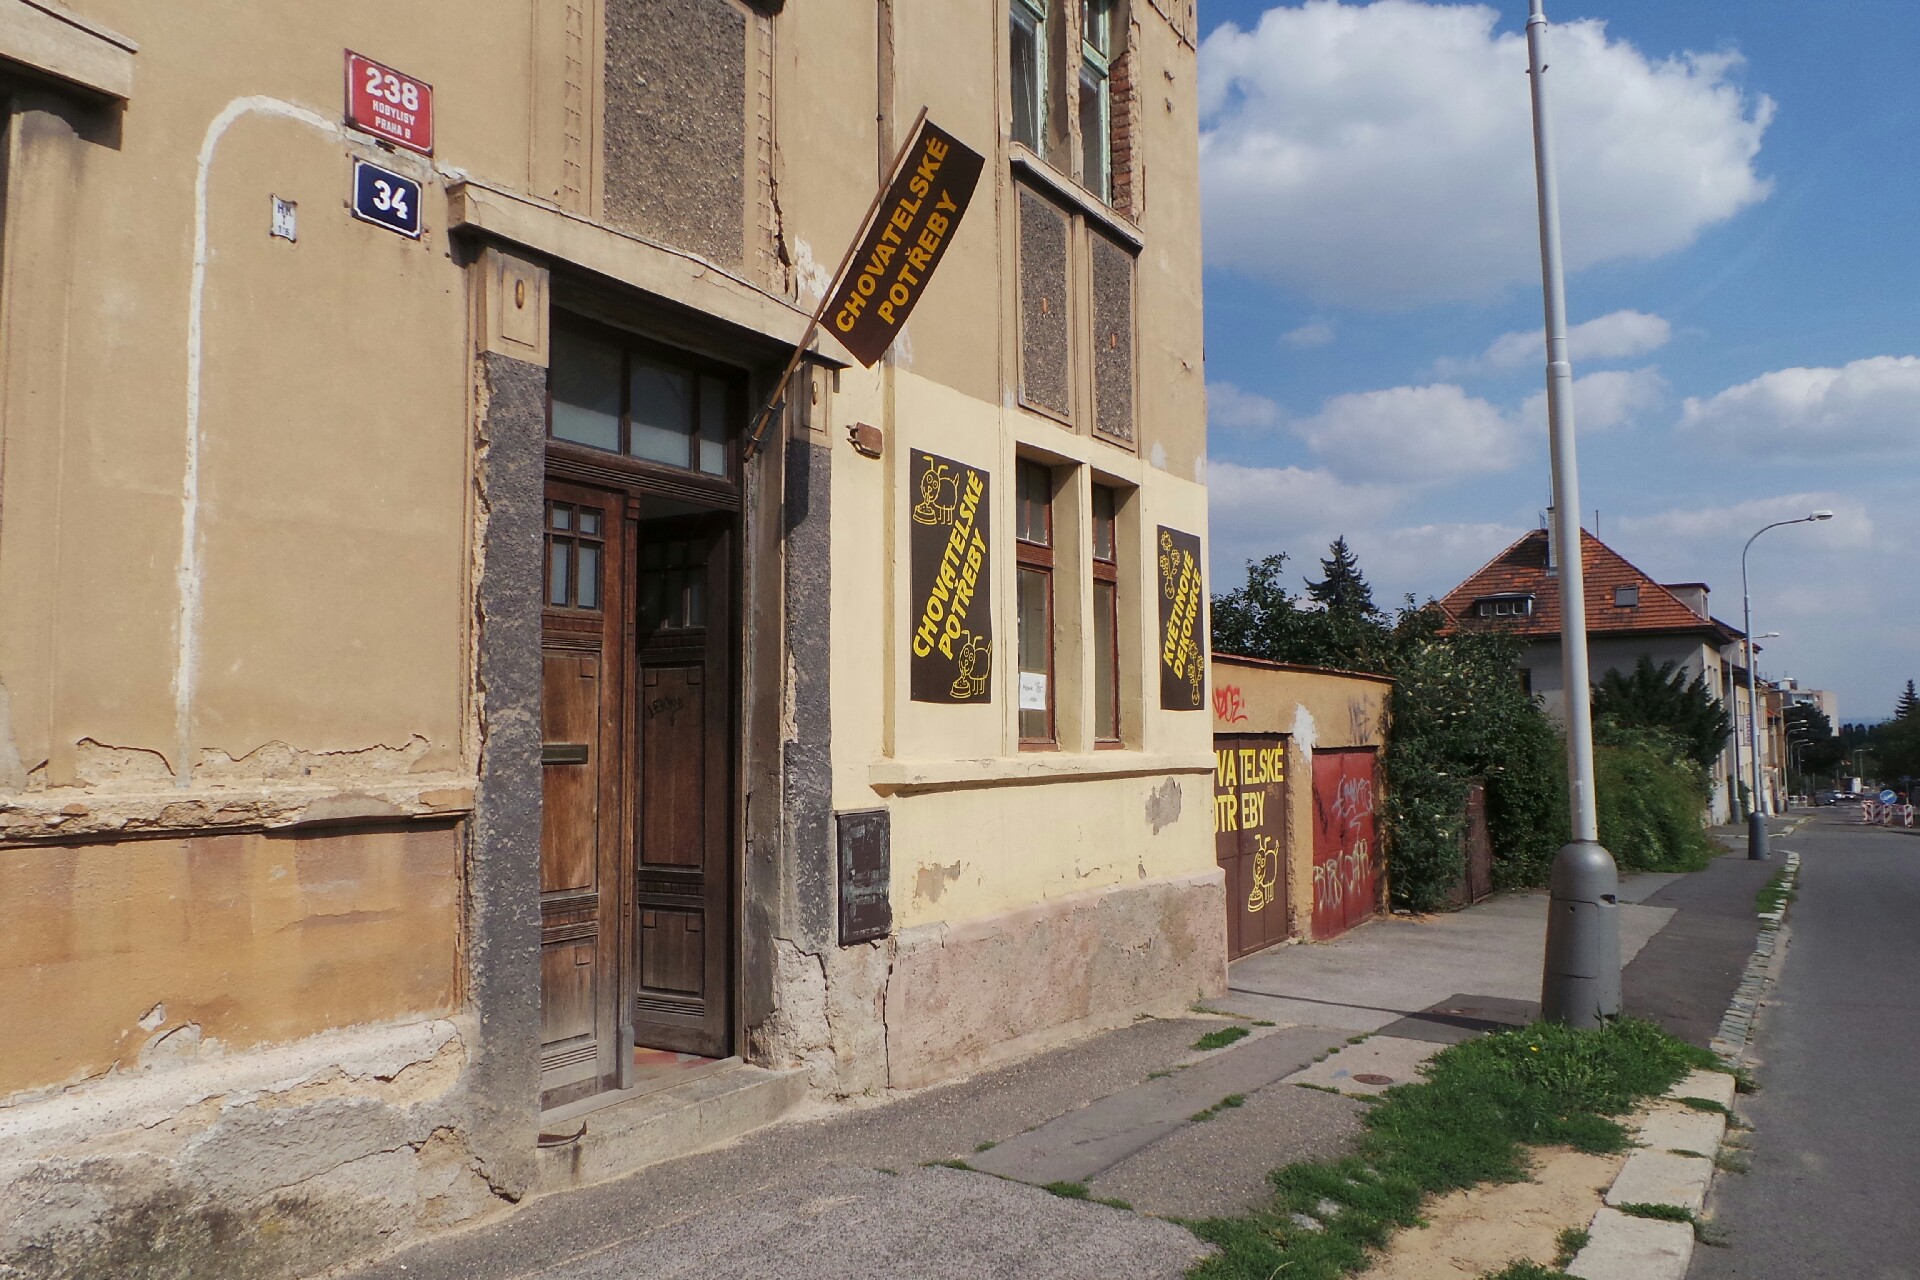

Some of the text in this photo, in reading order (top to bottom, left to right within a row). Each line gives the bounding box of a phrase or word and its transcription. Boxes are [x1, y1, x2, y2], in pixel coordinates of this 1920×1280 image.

[365, 66, 419, 111] 238
[372, 99, 416, 126] KOBYLISY
[375, 115, 402, 136] PRAHA
[373, 179, 408, 220] 34
[836, 137, 948, 332] CHOVATELSKÉ
[878, 189, 958, 325] POTŘEBY
[913, 469, 984, 658] CHOVATELSKÉ
[937, 528, 987, 661] POTŘEBY
[1162, 549, 1195, 668] KVĚTINOVÉ
[1173, 567, 1202, 680] DEKORACE
